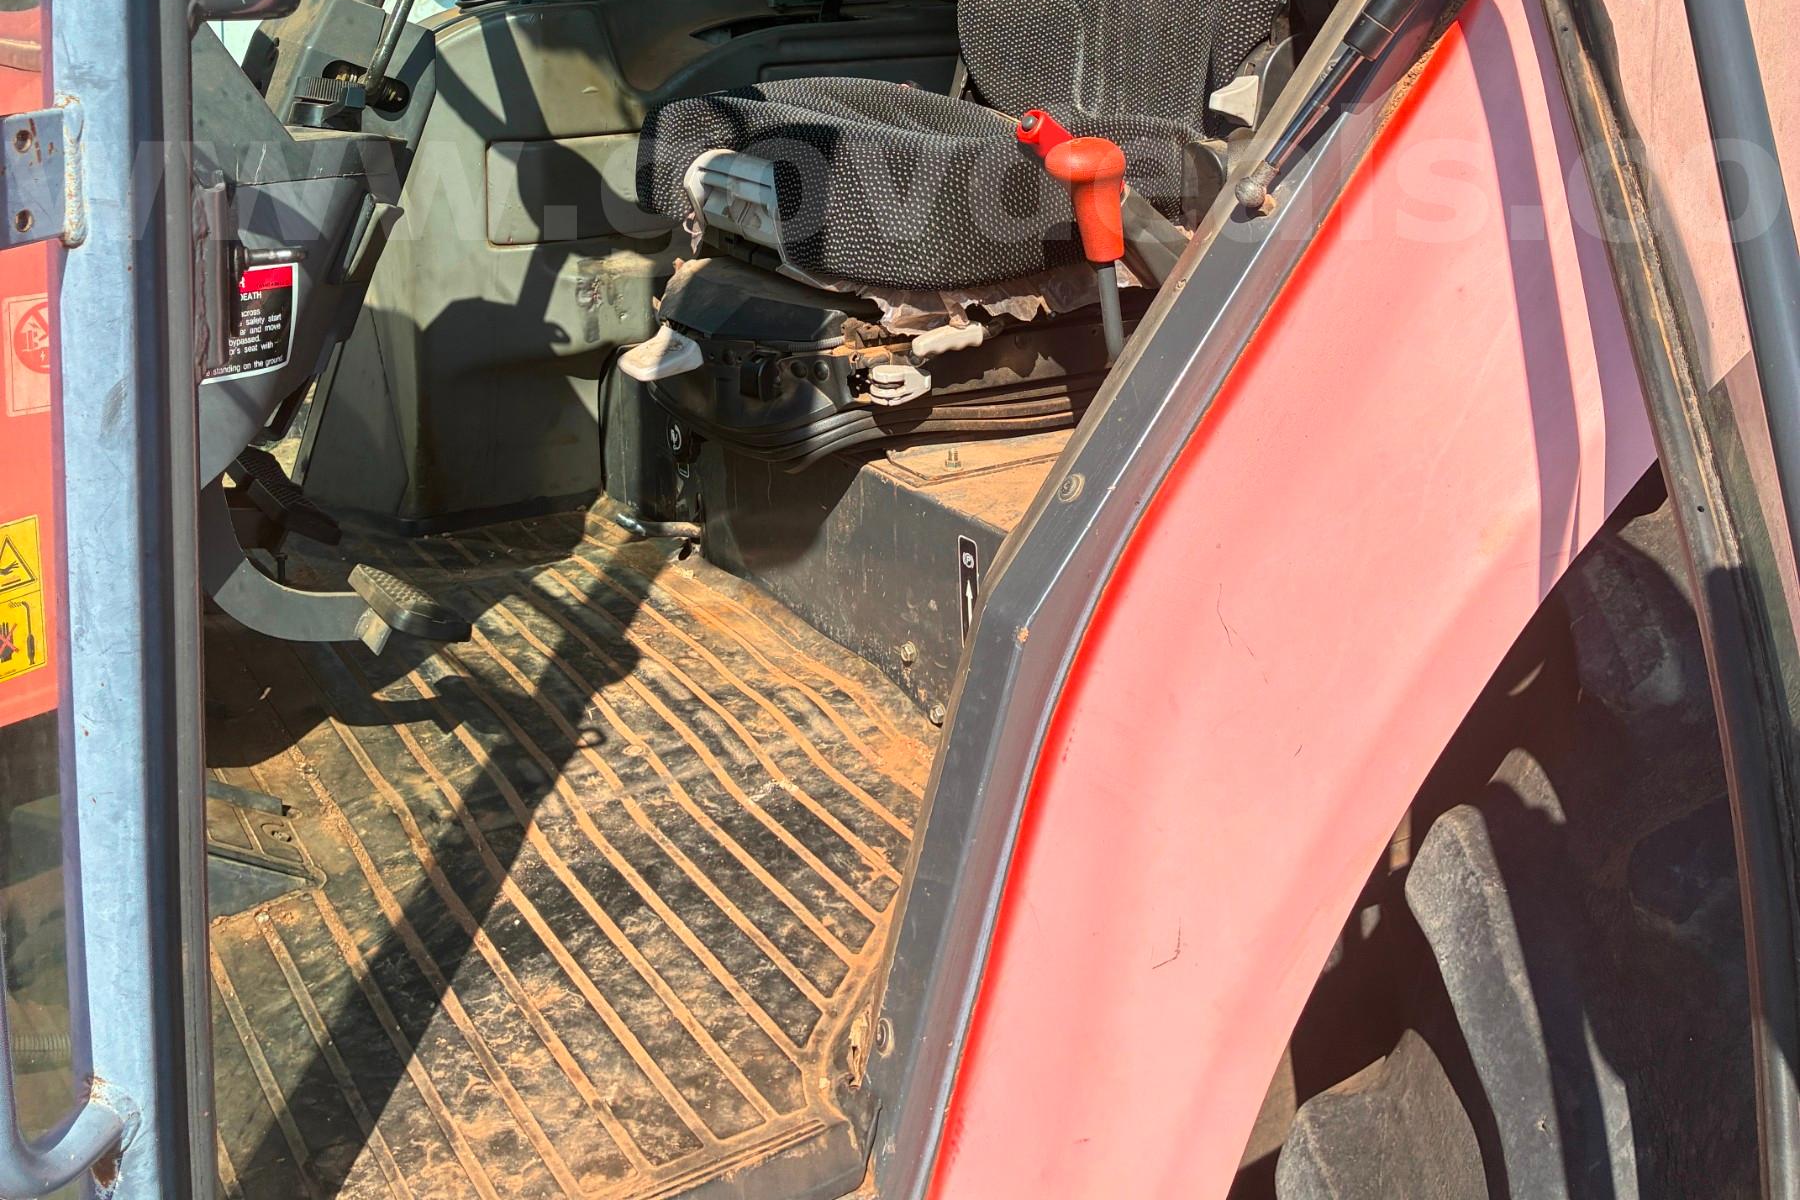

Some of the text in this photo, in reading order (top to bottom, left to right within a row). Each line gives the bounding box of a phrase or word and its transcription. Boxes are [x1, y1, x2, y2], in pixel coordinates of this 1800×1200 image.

[245, 313, 282, 326] safety start
[249, 325, 262, 334] and
[264, 323, 281, 332] move
[244, 344, 258, 353] seat
[260, 341, 274, 351] with
[213, 364, 241, 376] standing
[243, 362, 252, 370] on
[253, 360, 264, 368] the
